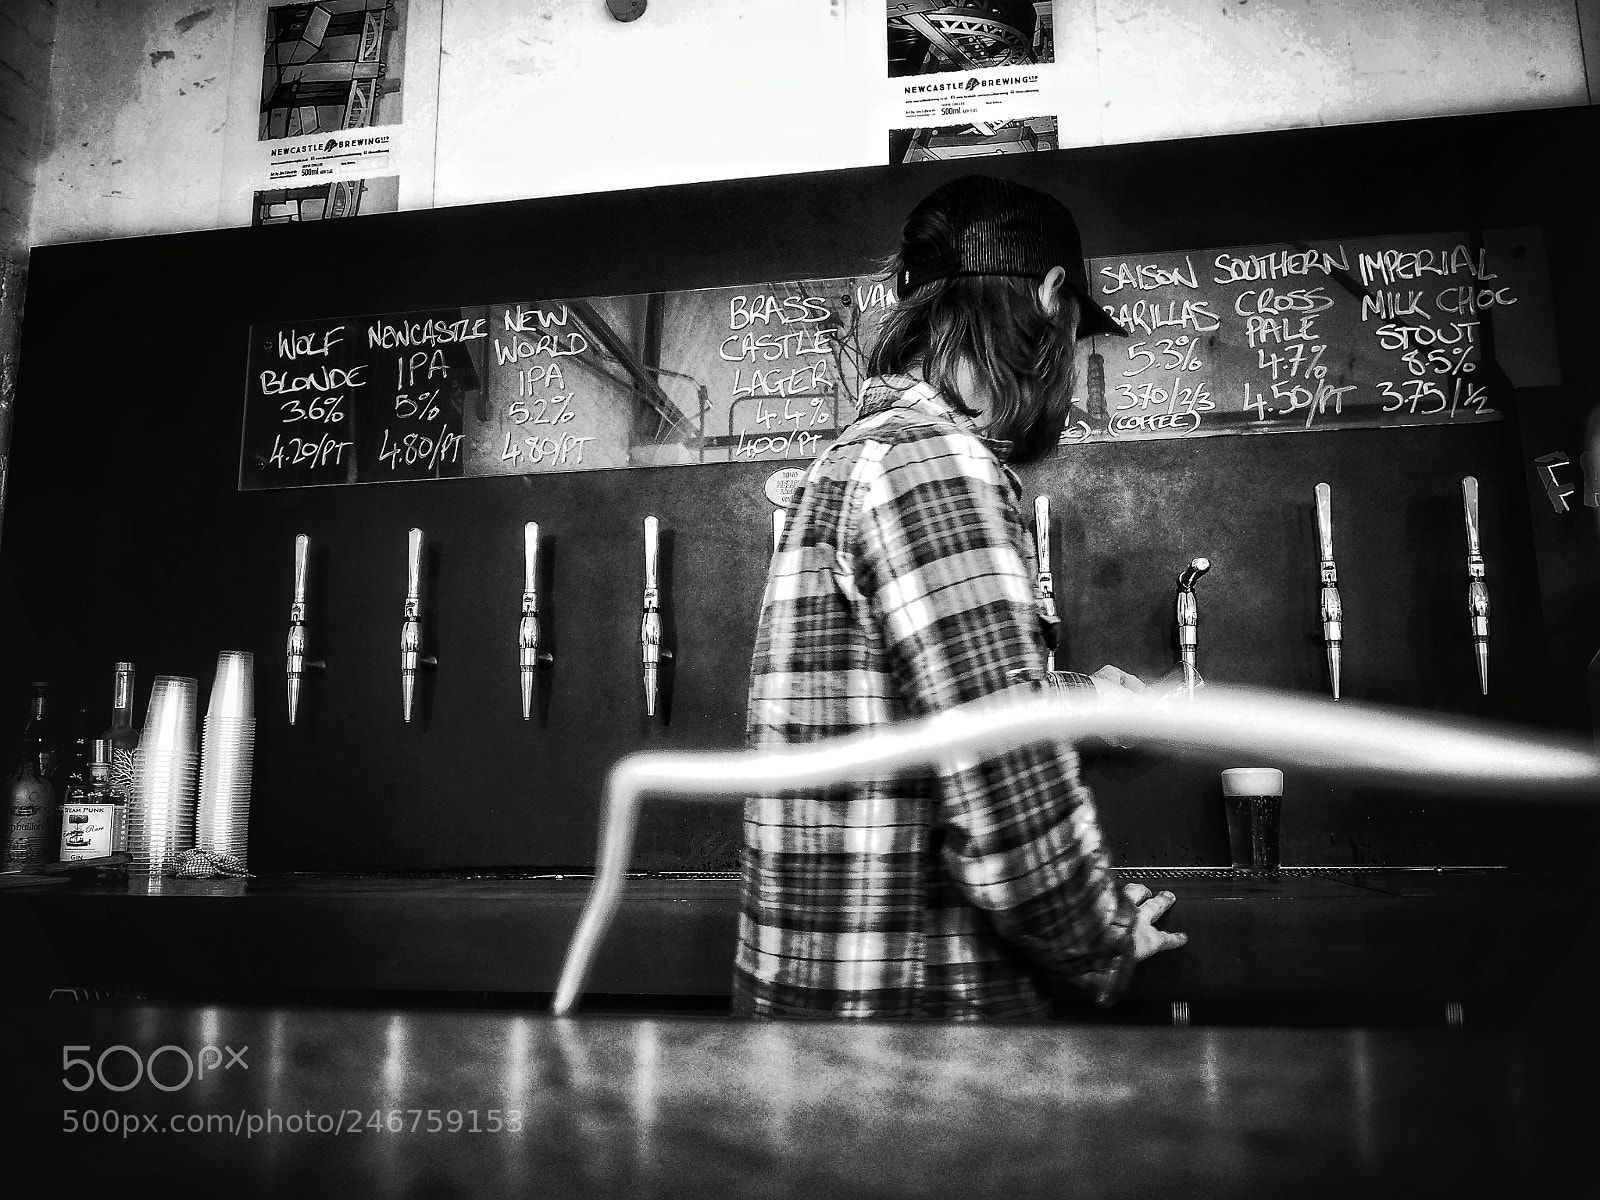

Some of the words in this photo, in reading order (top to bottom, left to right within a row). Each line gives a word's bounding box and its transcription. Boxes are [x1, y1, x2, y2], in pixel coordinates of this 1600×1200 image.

[904, 82, 964, 94] NEWCASTLE
[982, 76, 1028, 86] BREWING
[941, 107, 961, 116] 500ml
[270, 144, 324, 156] NEWCASTLE
[338, 137, 381, 148] BREWING
[301, 167, 319, 176] 500ml
[1100, 257, 1198, 294] SAISON
[1214, 245, 1350, 284] SOUTHERN
[1358, 245, 1498, 286] IMPERIAL
[730, 295, 831, 330] BRASS
[1235, 287, 1334, 316] CROSS
[1362, 290, 1431, 321] MILK
[1436, 286, 1518, 316] CHOC
[368, 318, 488, 350] NEWCASTLE
[504, 305, 568, 332] NEW
[1246, 314, 1320, 348] PALE
[278, 326, 345, 360] WOLF
[494, 334, 588, 366] WORLD
[720, 328, 837, 362] CASTLE
[1376, 322, 1480, 350] STOUT
[398, 349, 450, 390] IPA
[1123, 336, 1202, 377] 5.3%
[1258, 345, 1327, 380] 4.7%
[1402, 346, 1476, 375] 8.5%
[260, 365, 368, 395] BLONDE
[519, 364, 564, 395] IPA
[732, 360, 834, 397] LAGER
[281, 395, 345, 423] 3.6%
[394, 389, 440, 420] 5%
[509, 393, 575, 425] 5.2%
[756, 398, 829, 428] 4.4%
[1242, 378, 1357, 429] 4.50/PT
[1108, 412, 1201, 436] (COFFEE)
[269, 434, 353, 469] 4.20/PT
[379, 424, 466, 471] 4.80/PT
[501, 432, 596, 466] 4.80/PT
